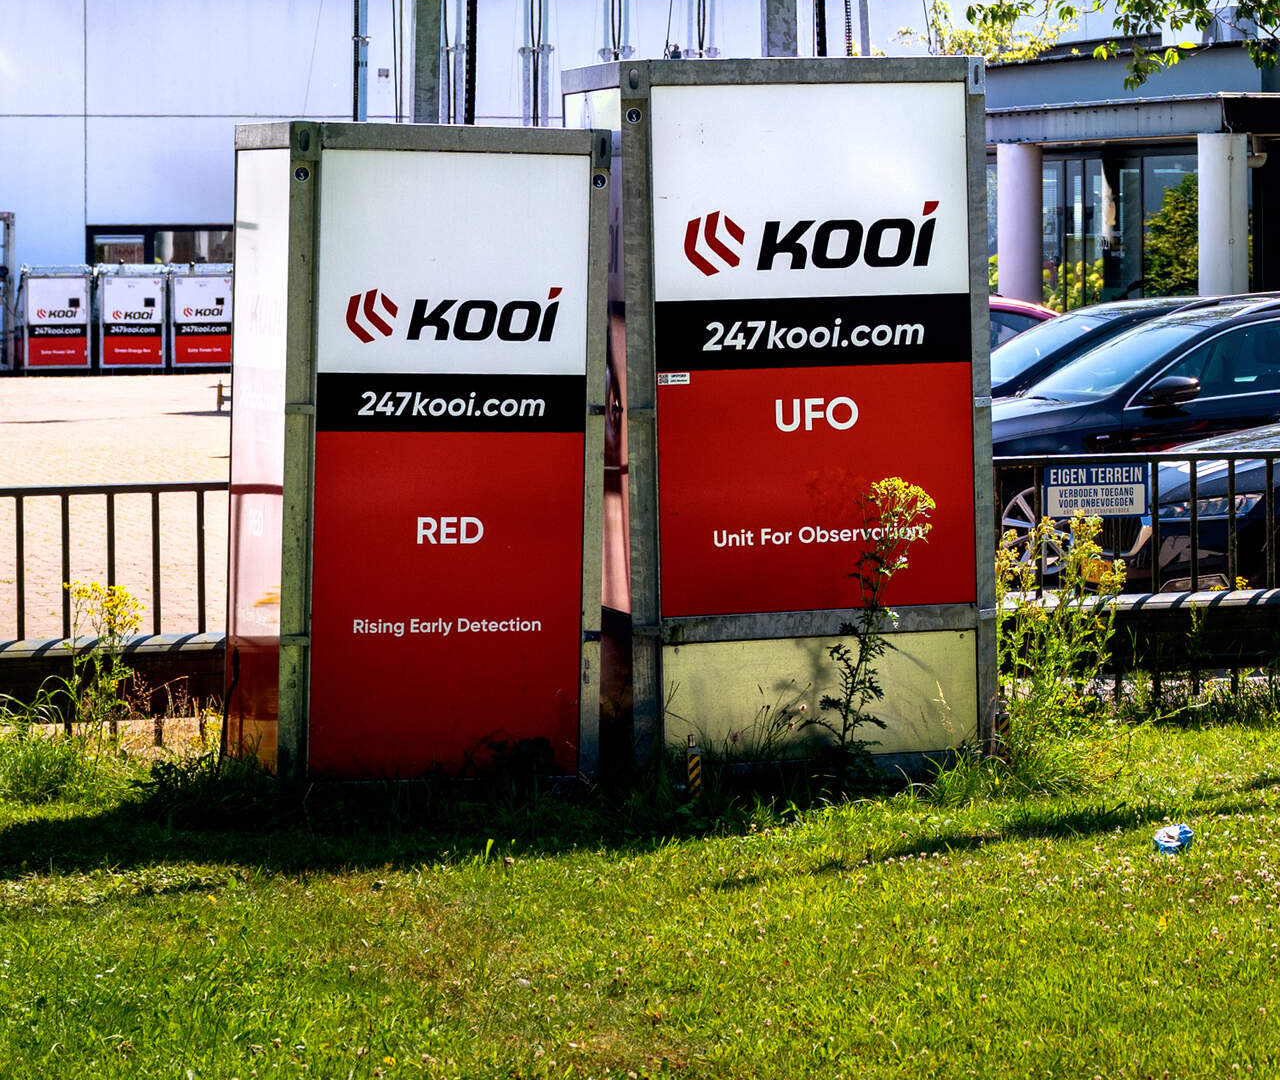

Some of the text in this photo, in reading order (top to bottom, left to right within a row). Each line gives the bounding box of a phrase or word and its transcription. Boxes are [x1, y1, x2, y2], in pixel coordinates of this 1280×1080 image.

[702, 318, 925, 352] 247kooi.com
[357, 391, 546, 417] 247kooi.com
[775, 396, 859, 432] UFO
[1050, 466, 1143, 485] EIGEN TERREIN
[1058, 497, 1134, 508] VOOR ONBEVOEGDEN
[1059, 486, 1134, 498] VERBODEN TOEGANG
[416, 516, 485, 545] RED
[713, 523, 924, 548] Unit For Observation
[353, 617, 542, 637] Rising Early Detection
